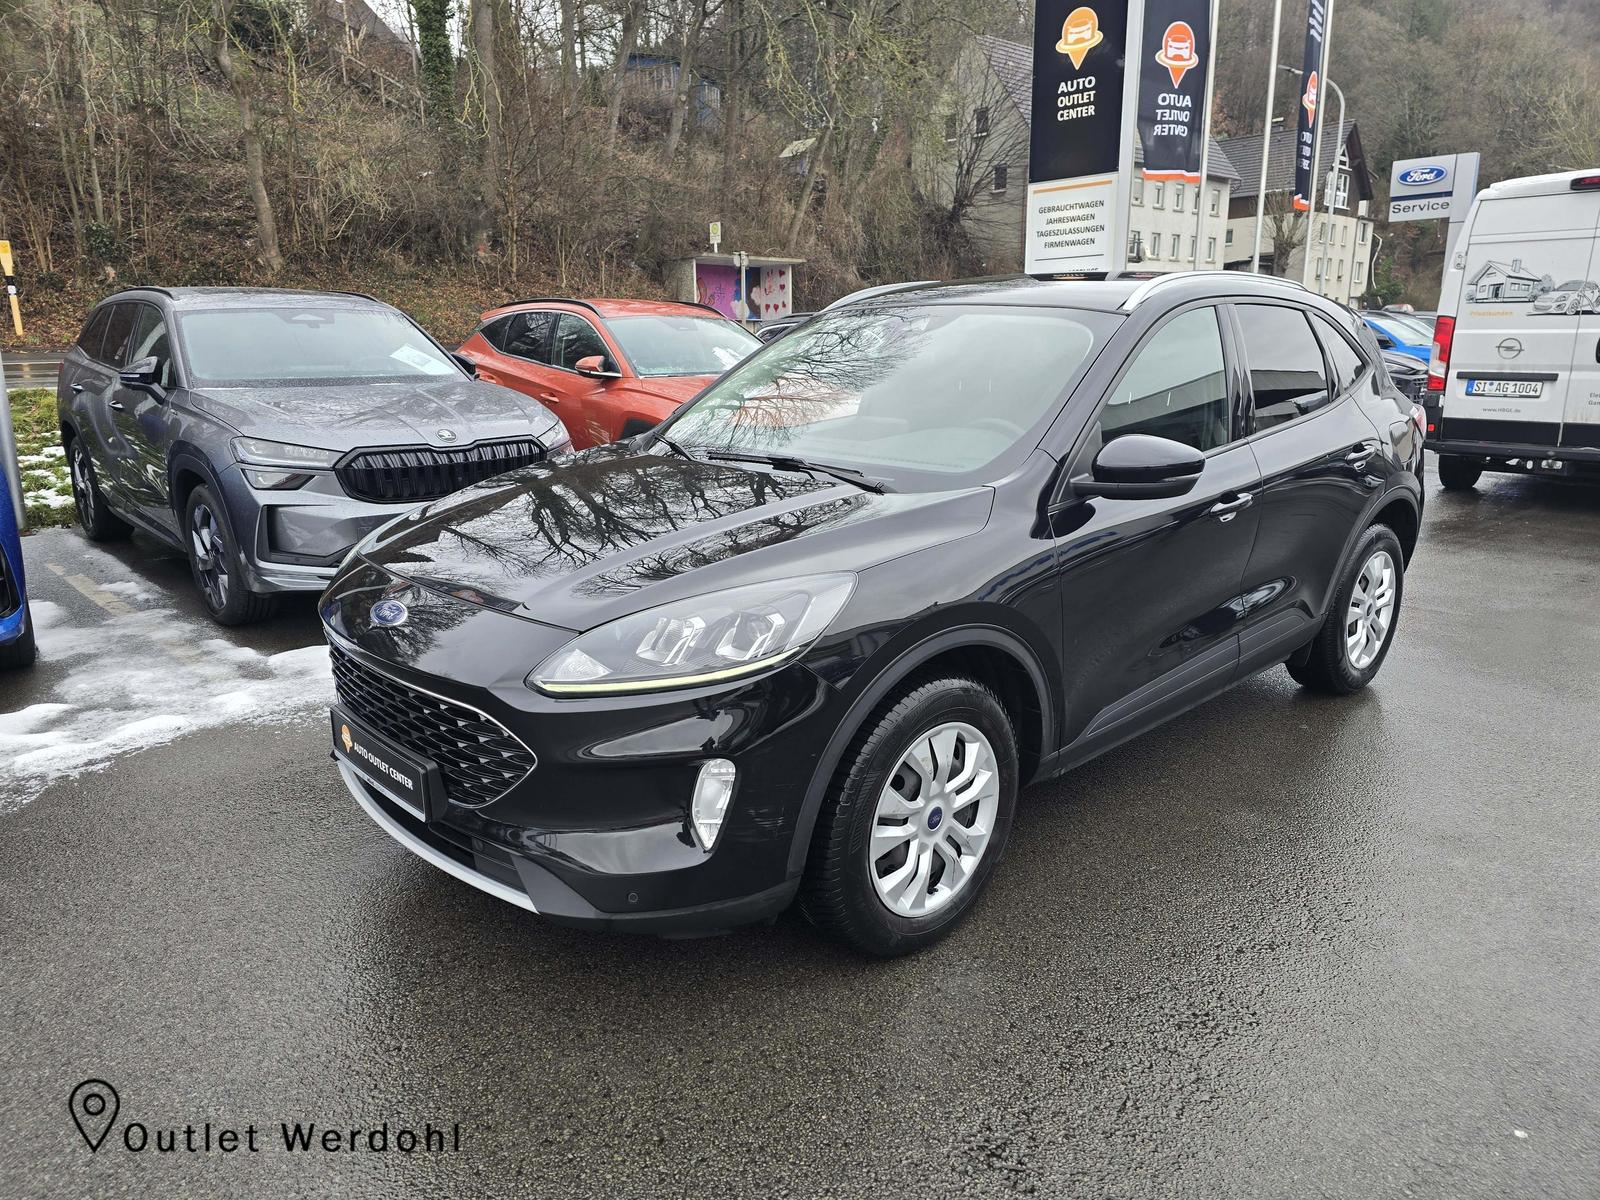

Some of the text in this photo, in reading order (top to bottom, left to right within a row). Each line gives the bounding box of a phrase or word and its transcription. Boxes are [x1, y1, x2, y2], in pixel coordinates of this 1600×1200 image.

[1057, 76, 1096, 94] AUTO
[1057, 91, 1096, 107] OUTLET
[1057, 105, 1095, 121] CENTER
[1406, 168, 1438, 182] Ford
[1038, 200, 1104, 214] GEBRAUCHTWAGEN
[1391, 201, 1450, 214] Service
[1046, 213, 1096, 225] JAHRESWAGEN
[1036, 224, 1105, 238] TAGESZULASSUNGEN
[1044, 237, 1096, 249] FIRMENWAGEN
[1474, 382, 1539, 394] SI AG 1004
[354, 742, 414, 791] AUTO OUTLET CENTER
